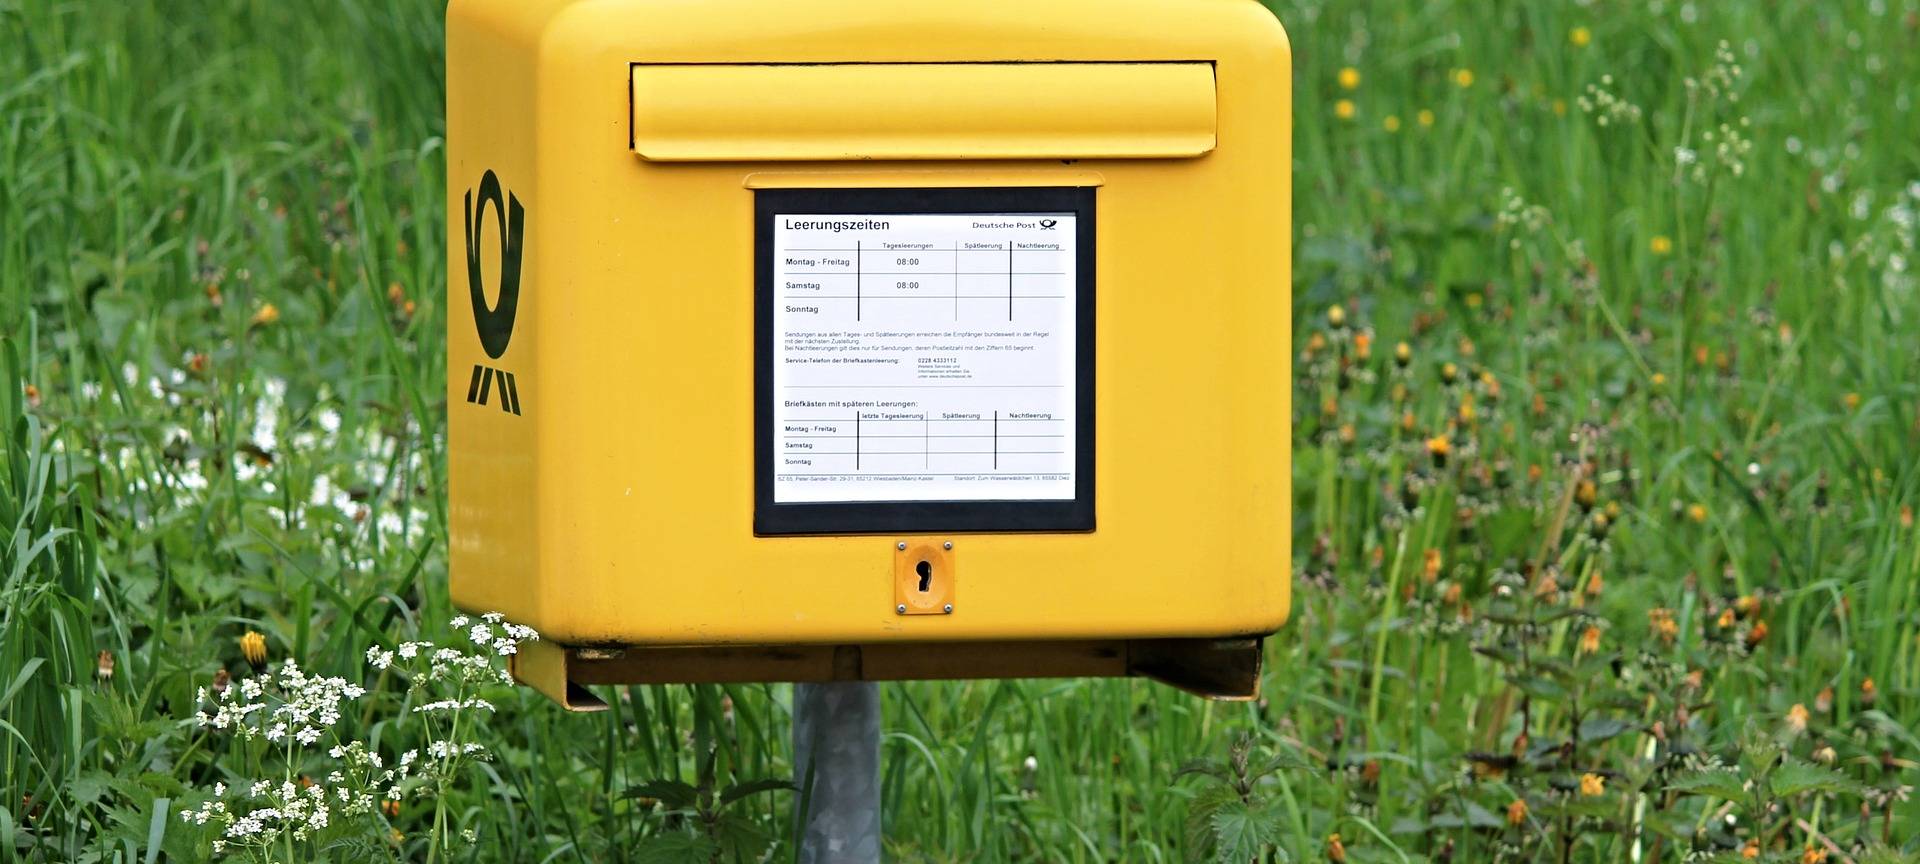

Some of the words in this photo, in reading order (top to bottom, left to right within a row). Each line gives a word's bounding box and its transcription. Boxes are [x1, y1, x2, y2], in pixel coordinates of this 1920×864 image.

[785, 219, 890, 232] Leerungszeiten
[882, 242, 934, 250] Tagesleerungen
[964, 242, 1003, 250] Spätleerung
[1017, 242, 1060, 250] Nachtleerung
[785, 258, 816, 267] Montag
[822, 258, 850, 267] Freitag
[896, 258, 919, 266] 08:00
[785, 281, 820, 290] Samstag
[896, 281, 919, 290] 08:00
[785, 305, 819, 314] Sonntag
